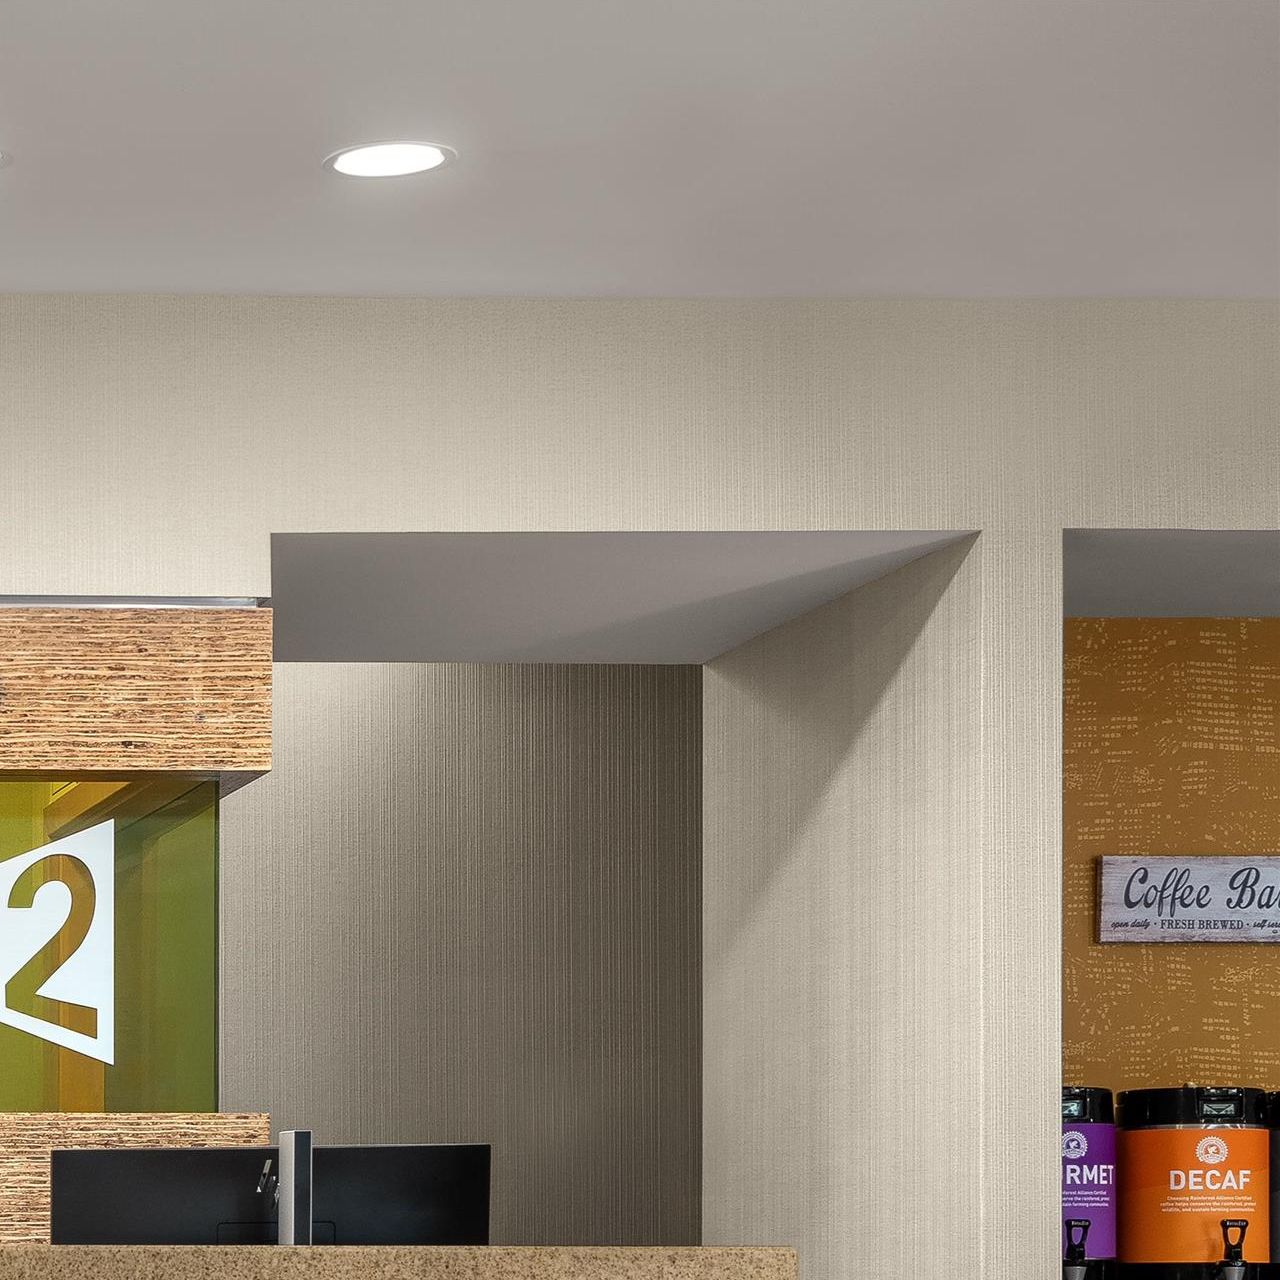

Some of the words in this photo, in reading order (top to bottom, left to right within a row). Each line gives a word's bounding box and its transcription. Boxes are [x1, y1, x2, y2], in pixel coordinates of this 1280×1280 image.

[1123, 866, 1212, 918] Coffee
[1110, 921, 1130, 931] open
[1130, 918, 1151, 930] daily
[1160, 919, 1195, 930] FRESH
[1197, 919, 1244, 930] BREWED
[3, 852, 99, 1041] 2
[1066, 1164, 1114, 1185] RMET
[1169, 1169, 1251, 1191] DECAF
